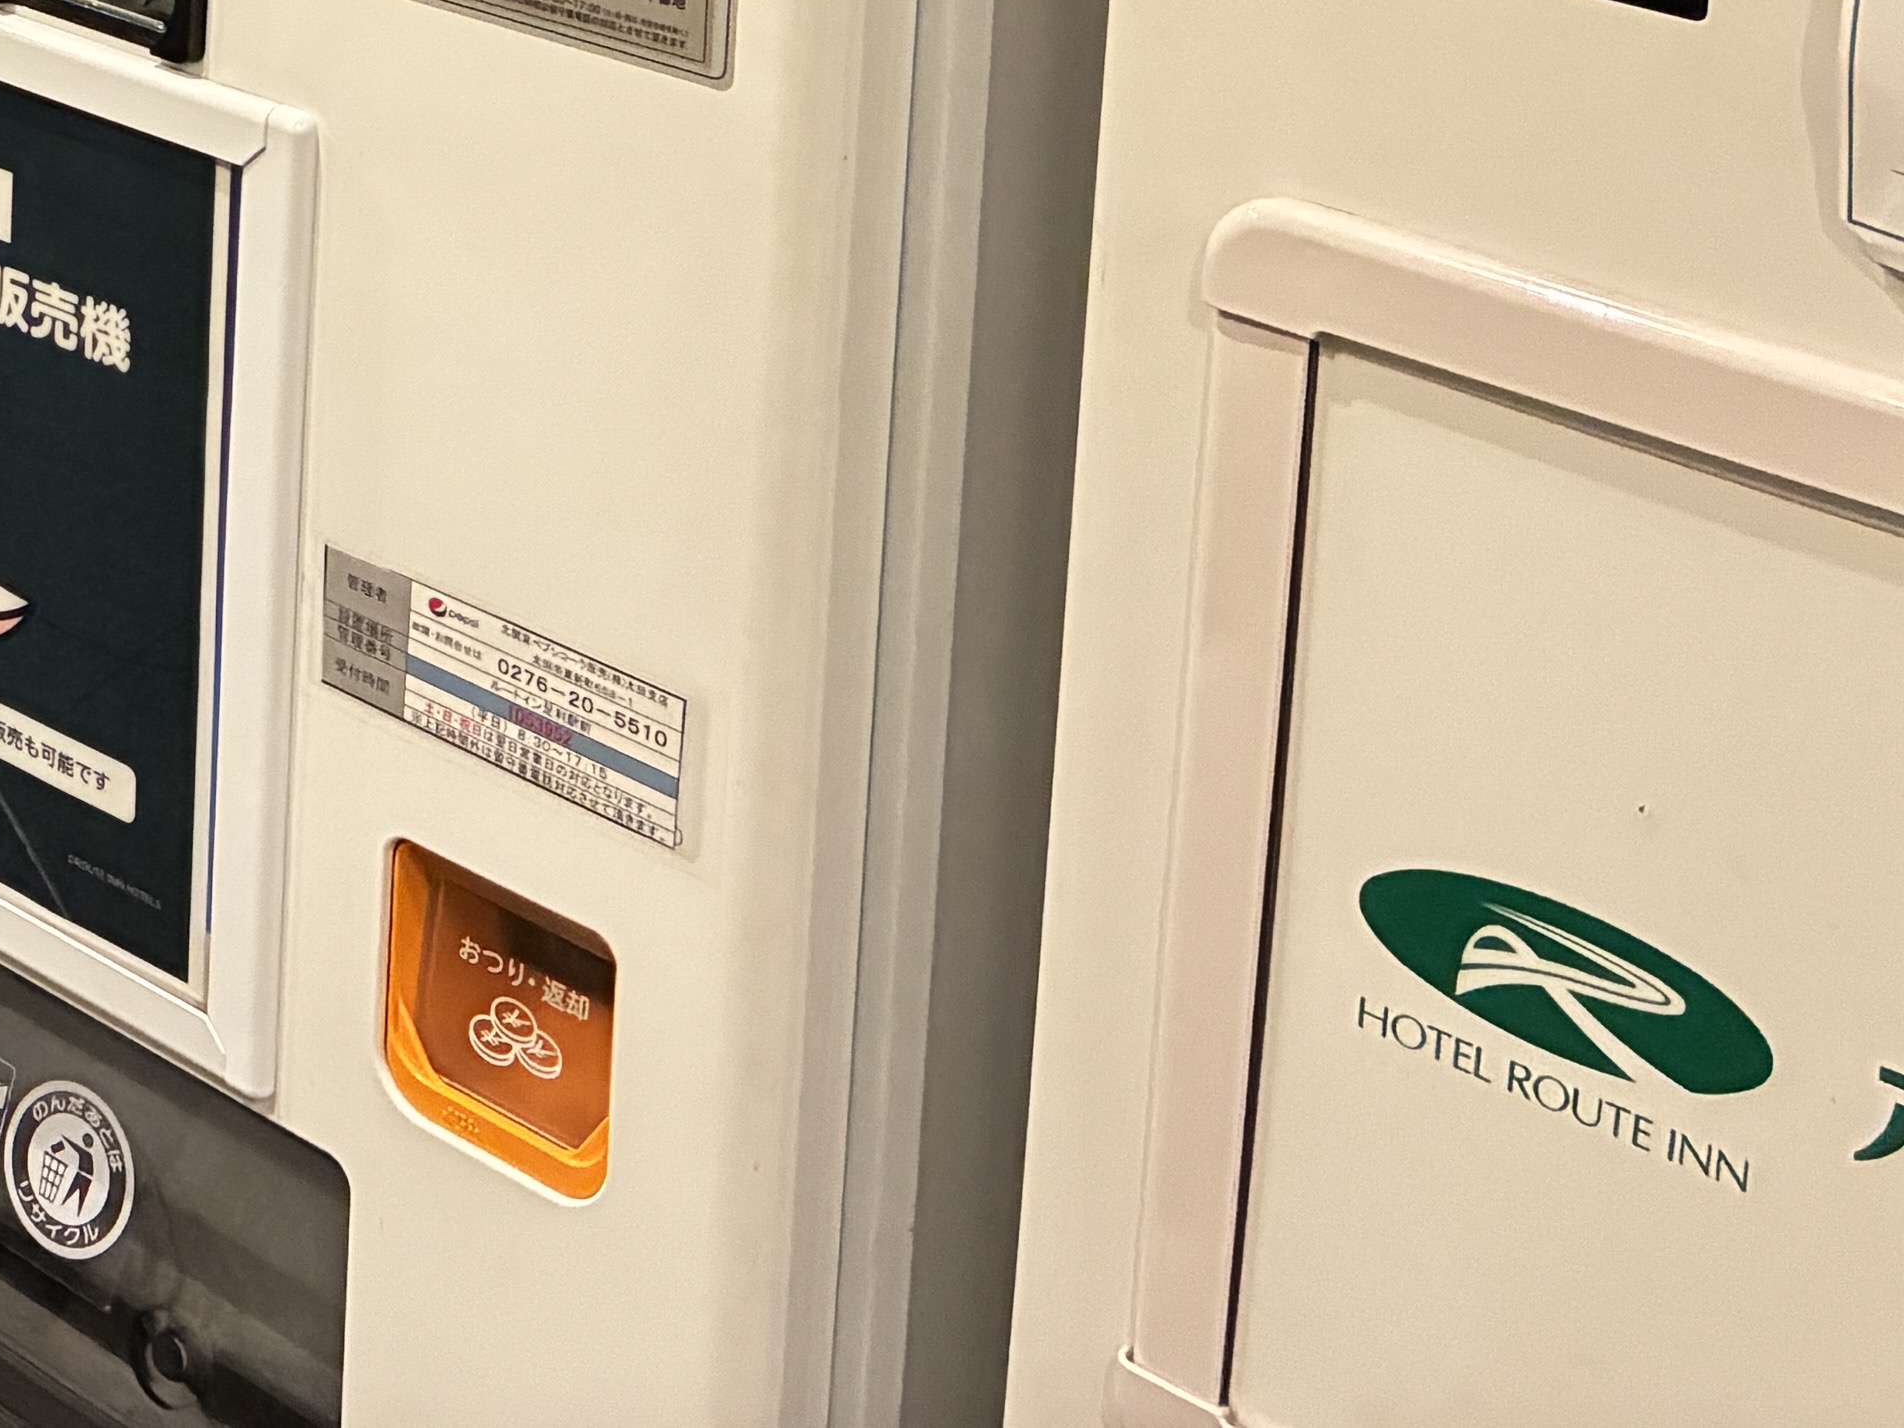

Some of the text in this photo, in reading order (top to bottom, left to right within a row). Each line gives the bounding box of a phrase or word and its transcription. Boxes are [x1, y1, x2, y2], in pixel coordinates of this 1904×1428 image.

[459, 936, 590, 1021] おつり・返却
[32, 1097, 124, 1172] のんだあとは
[1358, 997, 1749, 1193] HOTEL ROUTE INN
[19, 1181, 99, 1245] リサイクル
